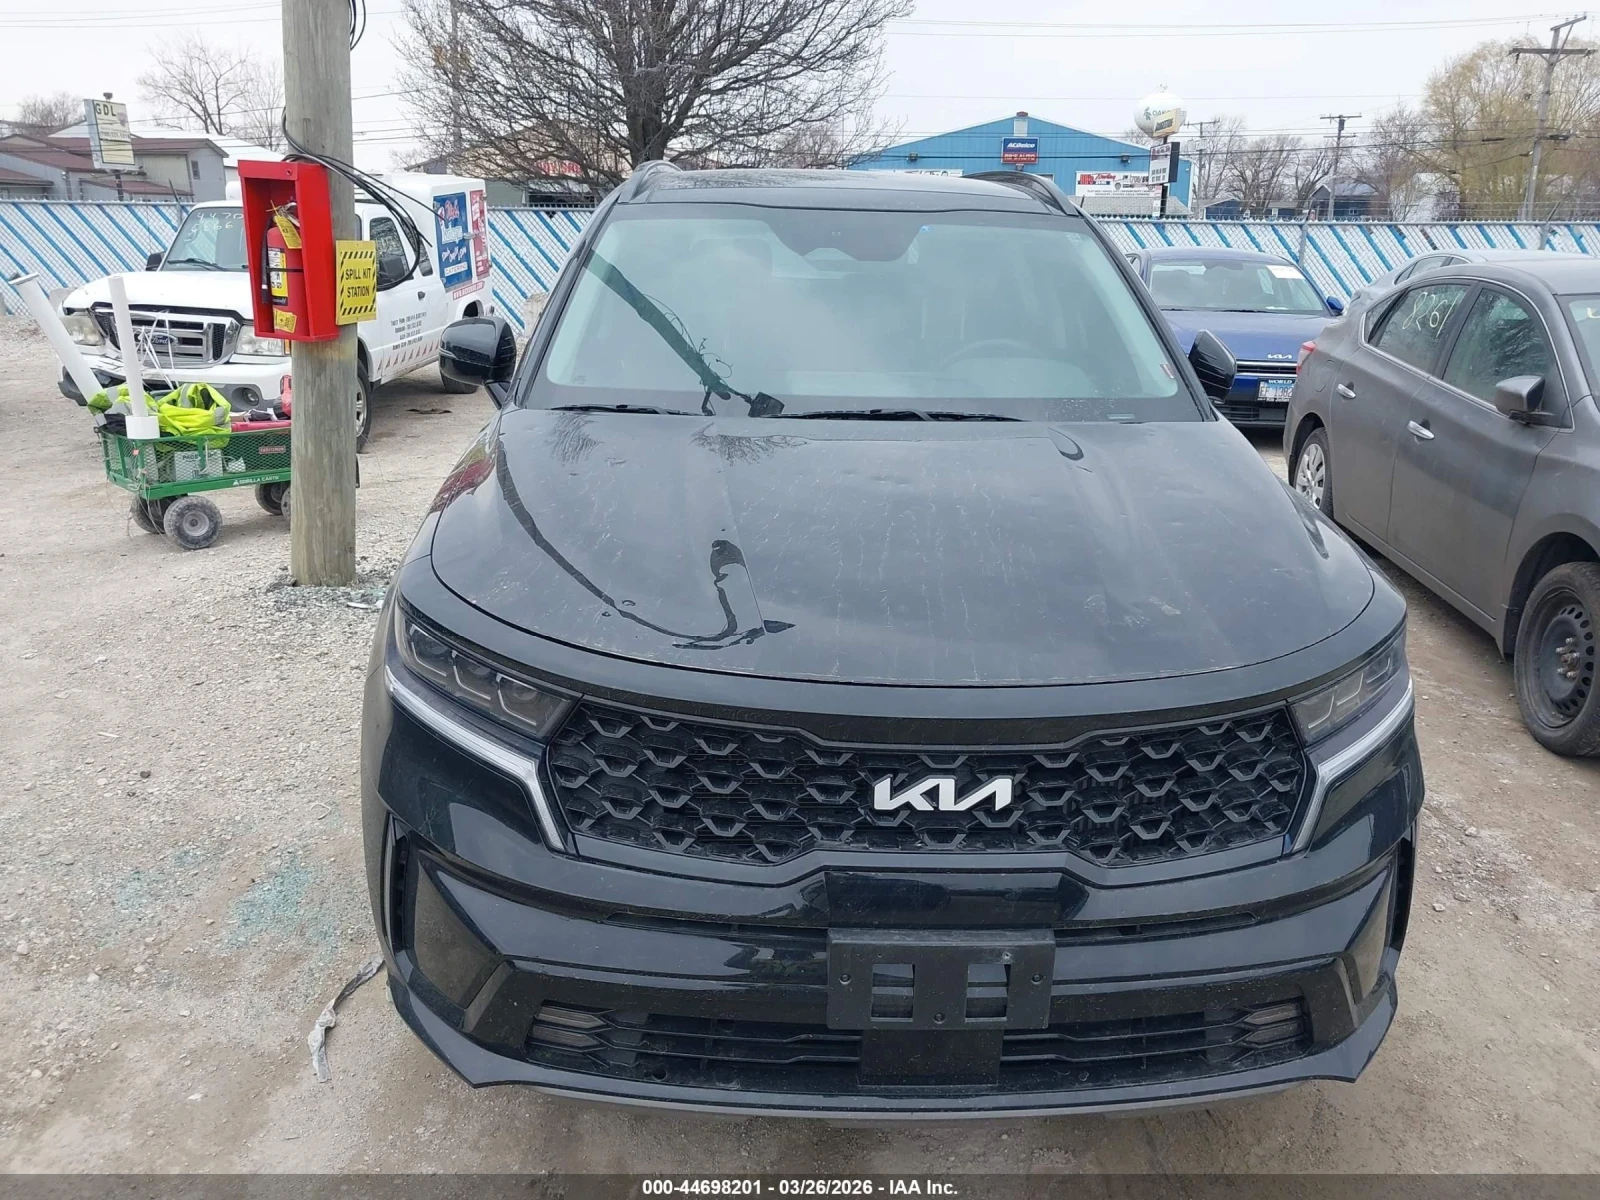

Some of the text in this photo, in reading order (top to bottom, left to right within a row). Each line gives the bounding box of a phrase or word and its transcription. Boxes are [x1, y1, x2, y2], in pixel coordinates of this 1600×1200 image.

[95, 103, 116, 117] GDL
[345, 267, 372, 280] SPILL KIT
[347, 285, 370, 298] STATION
[151, 335, 168, 345] Ford
[873, 775, 1013, 812] KIA
